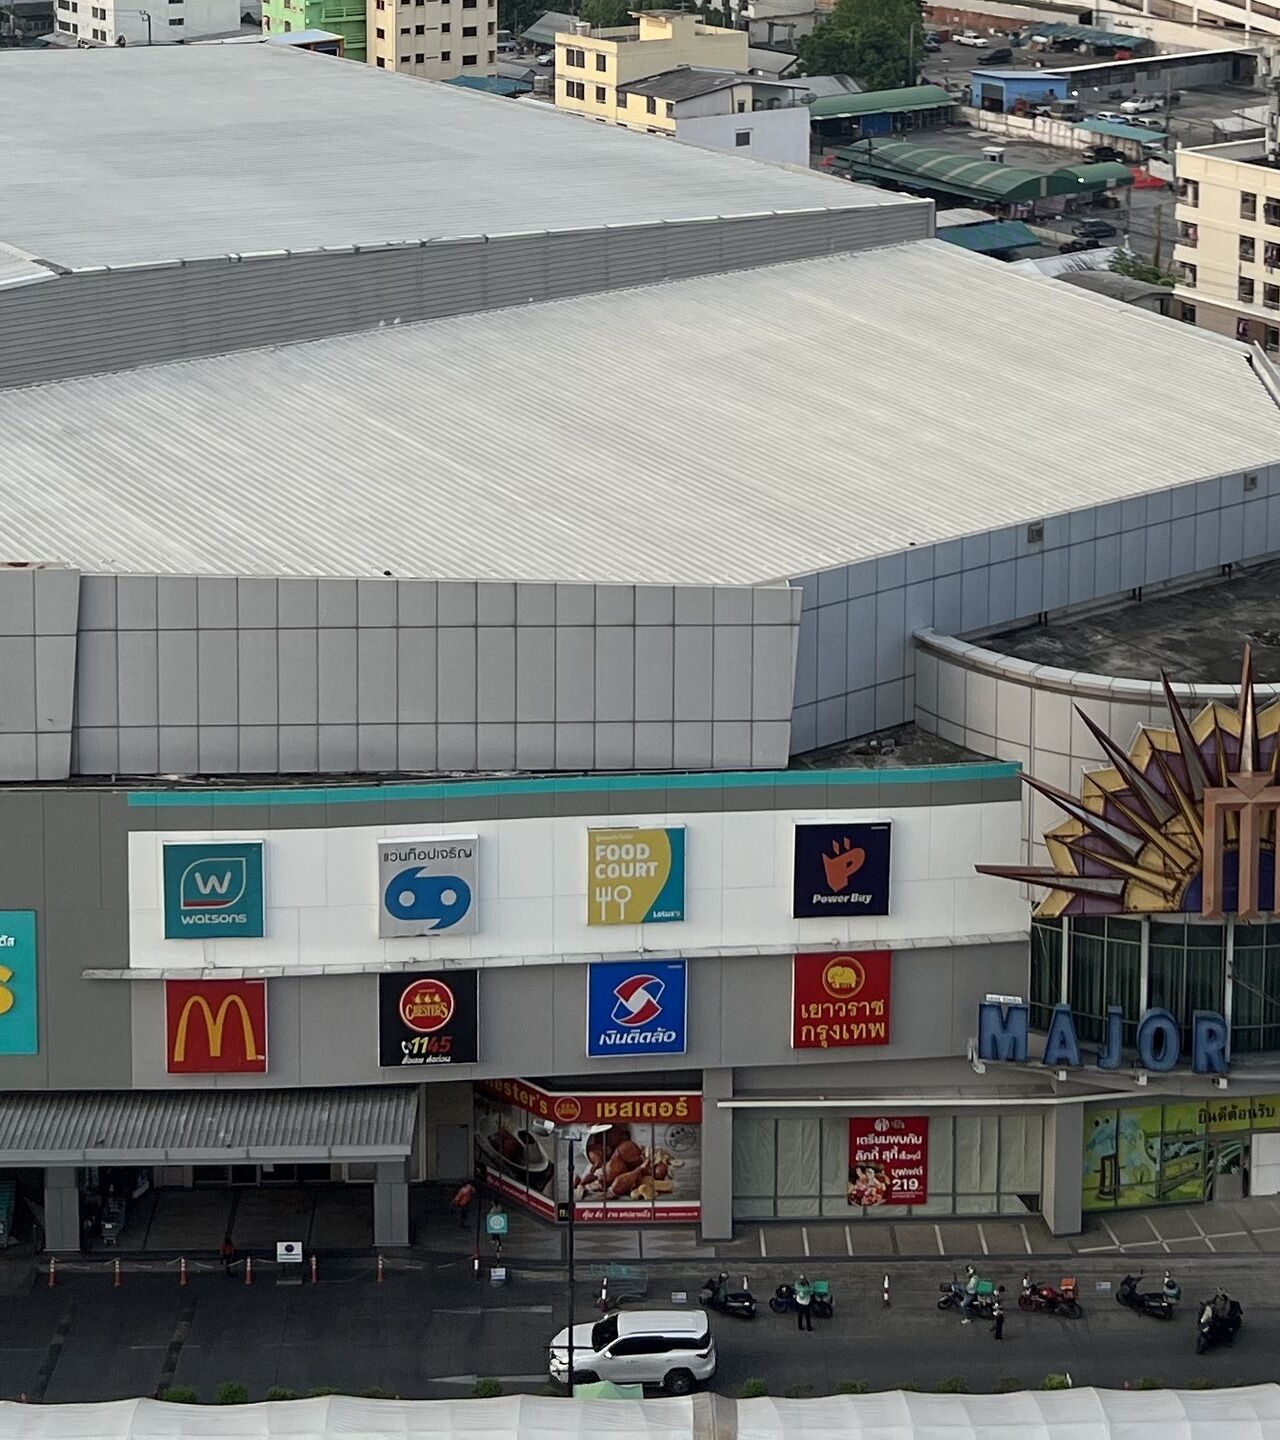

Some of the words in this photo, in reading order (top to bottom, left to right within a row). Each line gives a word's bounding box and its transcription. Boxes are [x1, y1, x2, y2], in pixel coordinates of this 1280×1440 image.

[383, 845, 473, 864] แว่นท็อปเจริญ
[595, 843, 650, 861] FOOD
[595, 861, 659, 879] COURT
[813, 892, 849, 905] Power
[851, 891, 873, 906] Buy
[180, 911, 247, 925] watsons
[801, 999, 885, 1020] เยาวราช
[411, 1035, 452, 1054] 1145
[598, 1027, 677, 1047] เงินติดล้อ
[801, 1022, 886, 1048] กรุงเทพ
[977, 1001, 1229, 1073] MAJOR
[596, 1096, 689, 1118] เชสเตอร์
[1198, 1103, 1276, 1125] ยินดีต้อนรับ
[856, 1133, 923, 1146] เตรียมพบกับ
